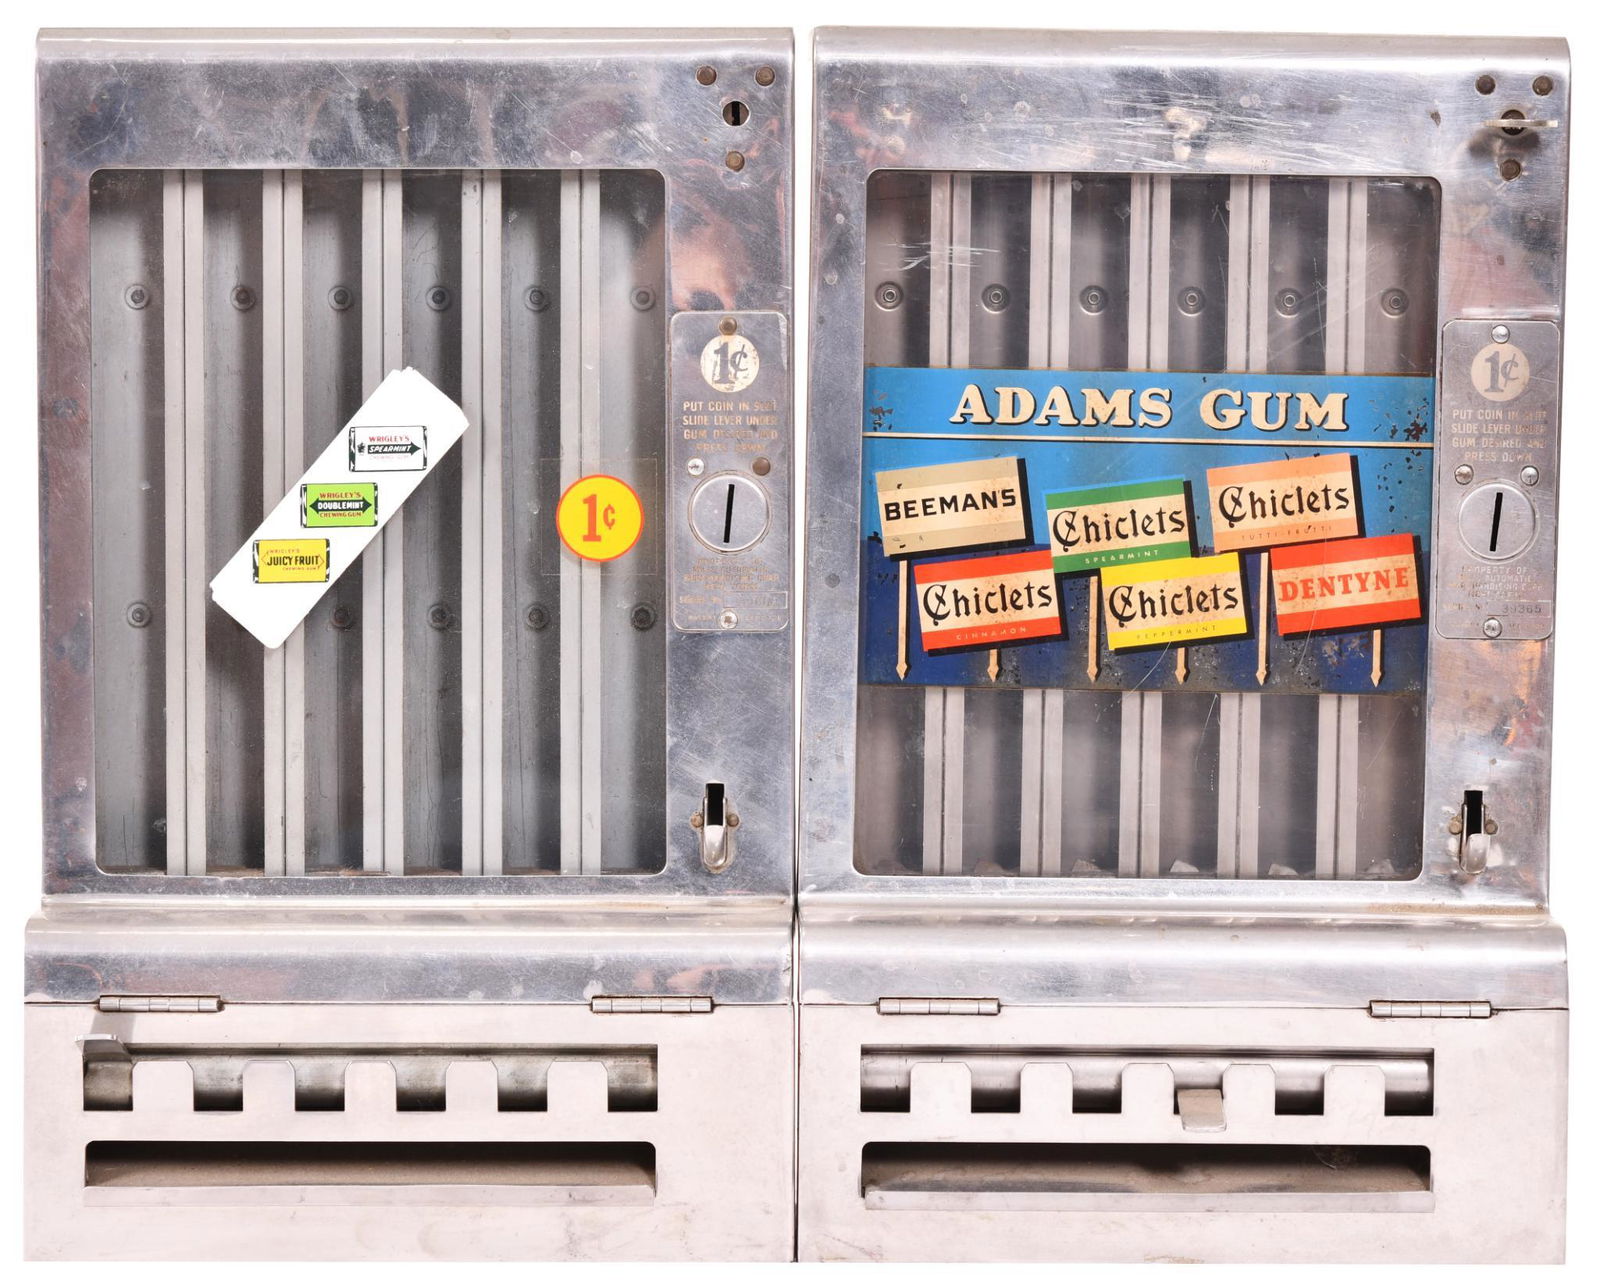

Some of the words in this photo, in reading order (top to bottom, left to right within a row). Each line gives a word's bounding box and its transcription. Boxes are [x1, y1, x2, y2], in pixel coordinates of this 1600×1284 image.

[683, 401, 704, 411] PUT
[708, 401, 734, 411] COIN
[739, 401, 750, 411] IN
[949, 384, 1172, 429] ADAMS
[1200, 388, 1349, 431] GUM
[682, 415, 709, 425] SLIDE
[714, 415, 742, 425] LEVER
[1452, 409, 1473, 420] PUT
[1478, 410, 1503, 420] COIN
[683, 429, 708, 440] GUM
[1451, 424, 1478, 434] SLIDE
[1483, 424, 1511, 434] LEVER
[368, 445, 412, 453] SPEARMINT
[1452, 437, 1476, 448] GUM
[1482, 438, 1521, 449] DESIRED
[1465, 452, 1497, 462] PRESS
[319, 491, 363, 499] WRIGLEY'S
[317, 501, 364, 510] DOUBLEMINT
[884, 488, 1017, 521] BEEMAN'S
[1218, 483, 1350, 529] Chiclets
[582, 493, 616, 542] 1¢
[1053, 506, 1186, 552] Chiclets
[267, 556, 293, 566] JUICY
[294, 555, 320, 565] FRUIT
[1085, 549, 1160, 565] SPEARMINT
[1278, 567, 1410, 602] DENTYNE
[923, 581, 1053, 626] Chiclets
[1109, 582, 1239, 628] Chiclets
[956, 626, 1028, 641] CINNAMON
[1136, 624, 1218, 640] PEPPERMINT
